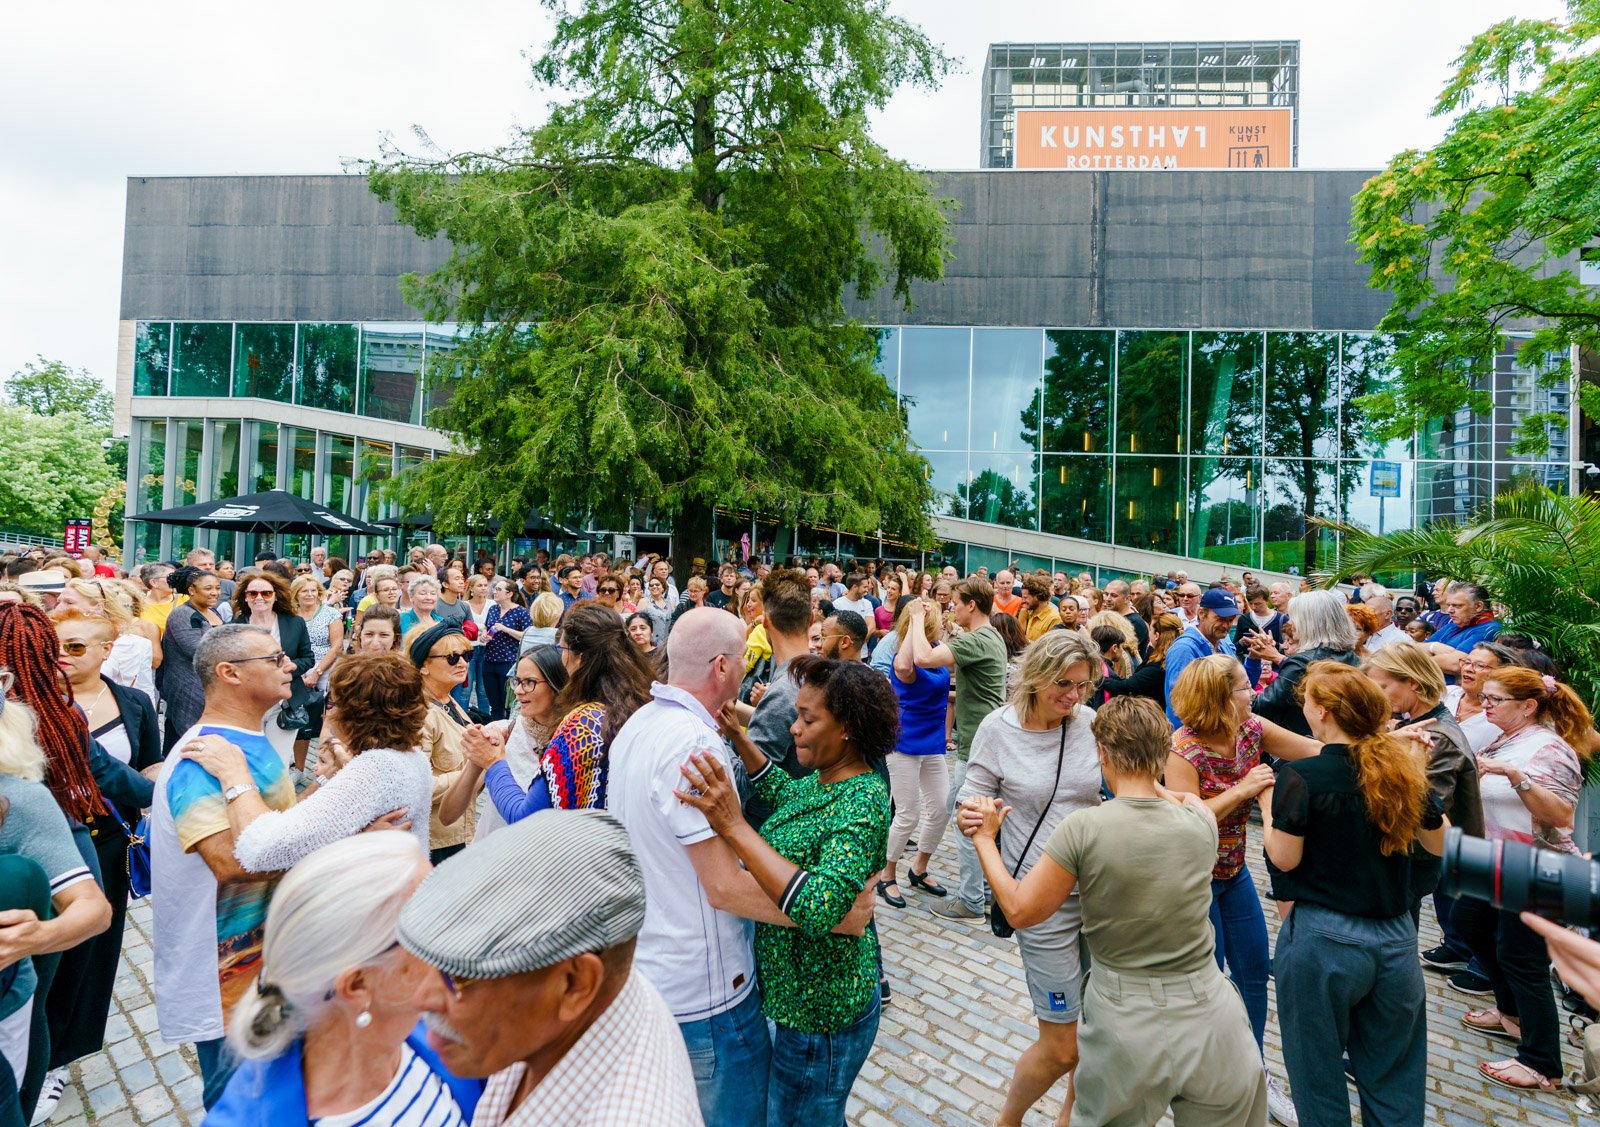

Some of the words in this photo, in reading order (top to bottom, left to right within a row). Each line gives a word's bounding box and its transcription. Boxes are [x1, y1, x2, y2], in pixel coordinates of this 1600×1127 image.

[1041, 125, 1206, 148] KUNSTHAL
[1229, 125, 1267, 134] KUNST
[1237, 134, 1259, 142] HAL
[1066, 154, 1178, 168] ROTTERDAM
[66, 528, 76, 549] LIVE
[78, 529, 89, 550] LIVE
